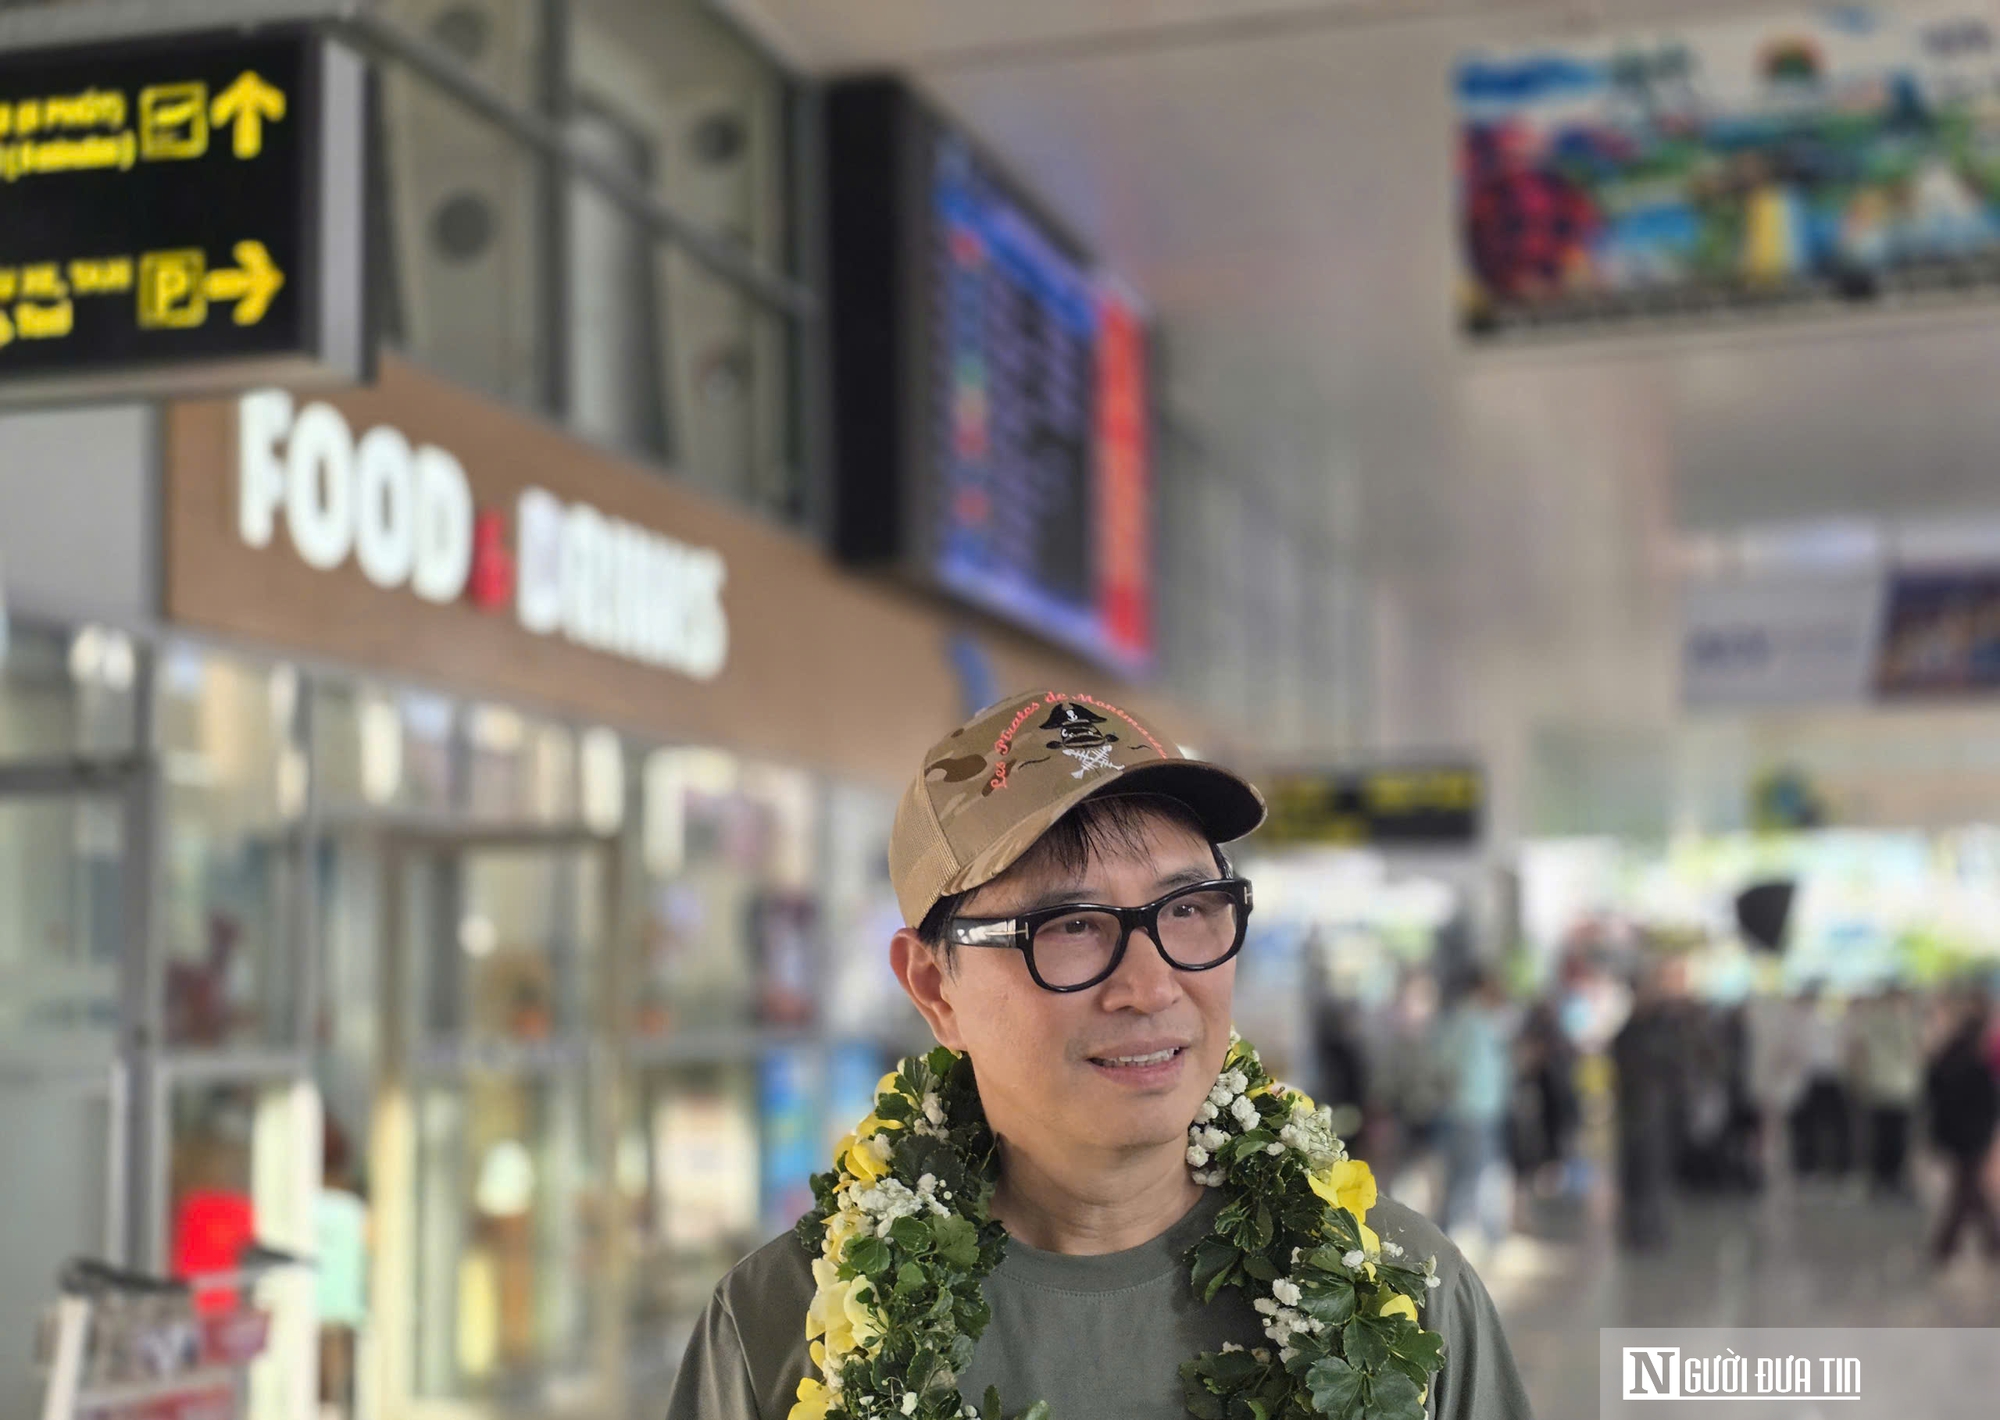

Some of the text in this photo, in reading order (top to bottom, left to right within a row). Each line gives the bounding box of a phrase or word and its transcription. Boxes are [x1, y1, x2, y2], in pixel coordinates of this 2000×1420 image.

[238, 388, 474, 603] FOOD
[990, 761, 1007, 789] Les
[1044, 691, 1069, 703] de
